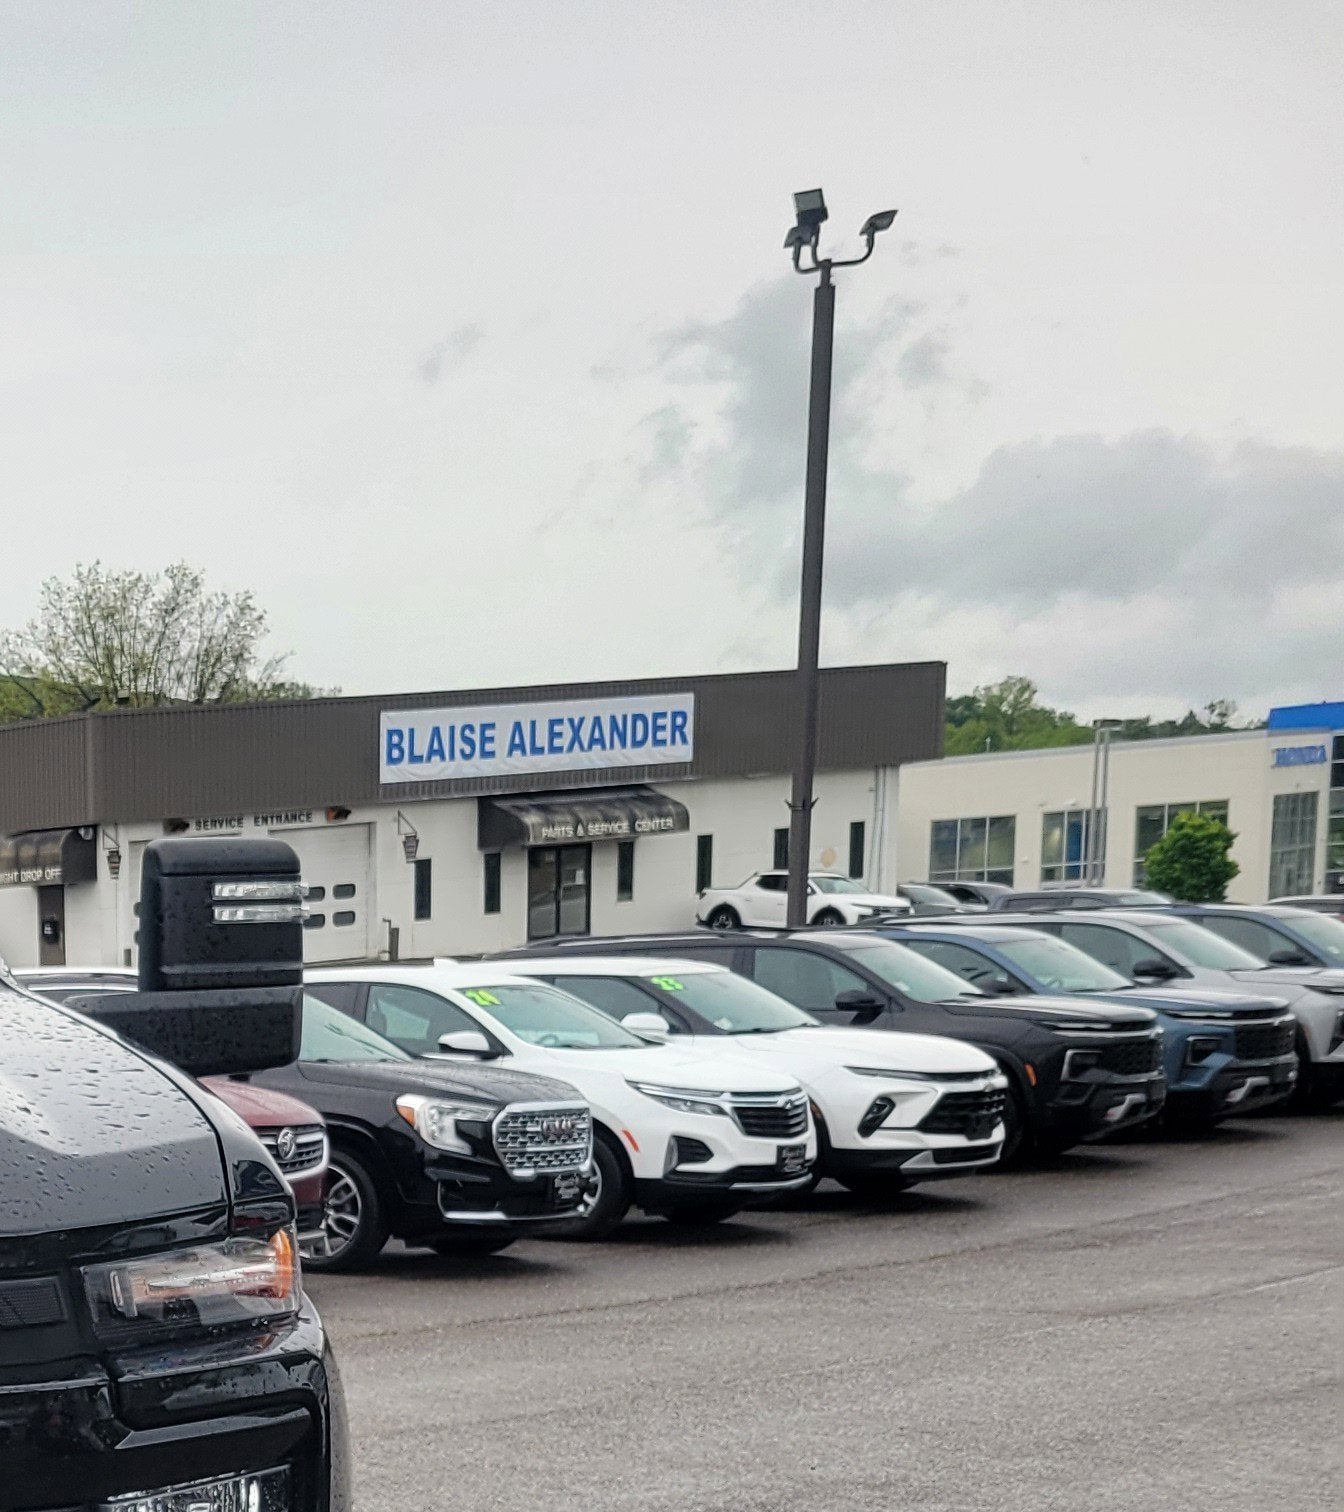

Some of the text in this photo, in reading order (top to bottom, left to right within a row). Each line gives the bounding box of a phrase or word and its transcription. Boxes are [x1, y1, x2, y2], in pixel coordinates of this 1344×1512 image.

[385, 710, 690, 766] BLAISE ALEXANDER
[195, 812, 312, 831] SERVICE ENTRANCE
[541, 825, 574, 838] PARTS
[587, 821, 630, 835] SERVICE
[634, 817, 673, 832] CENTER
[20, 868, 43, 882] DROP
[44, 868, 63, 880] OFF
